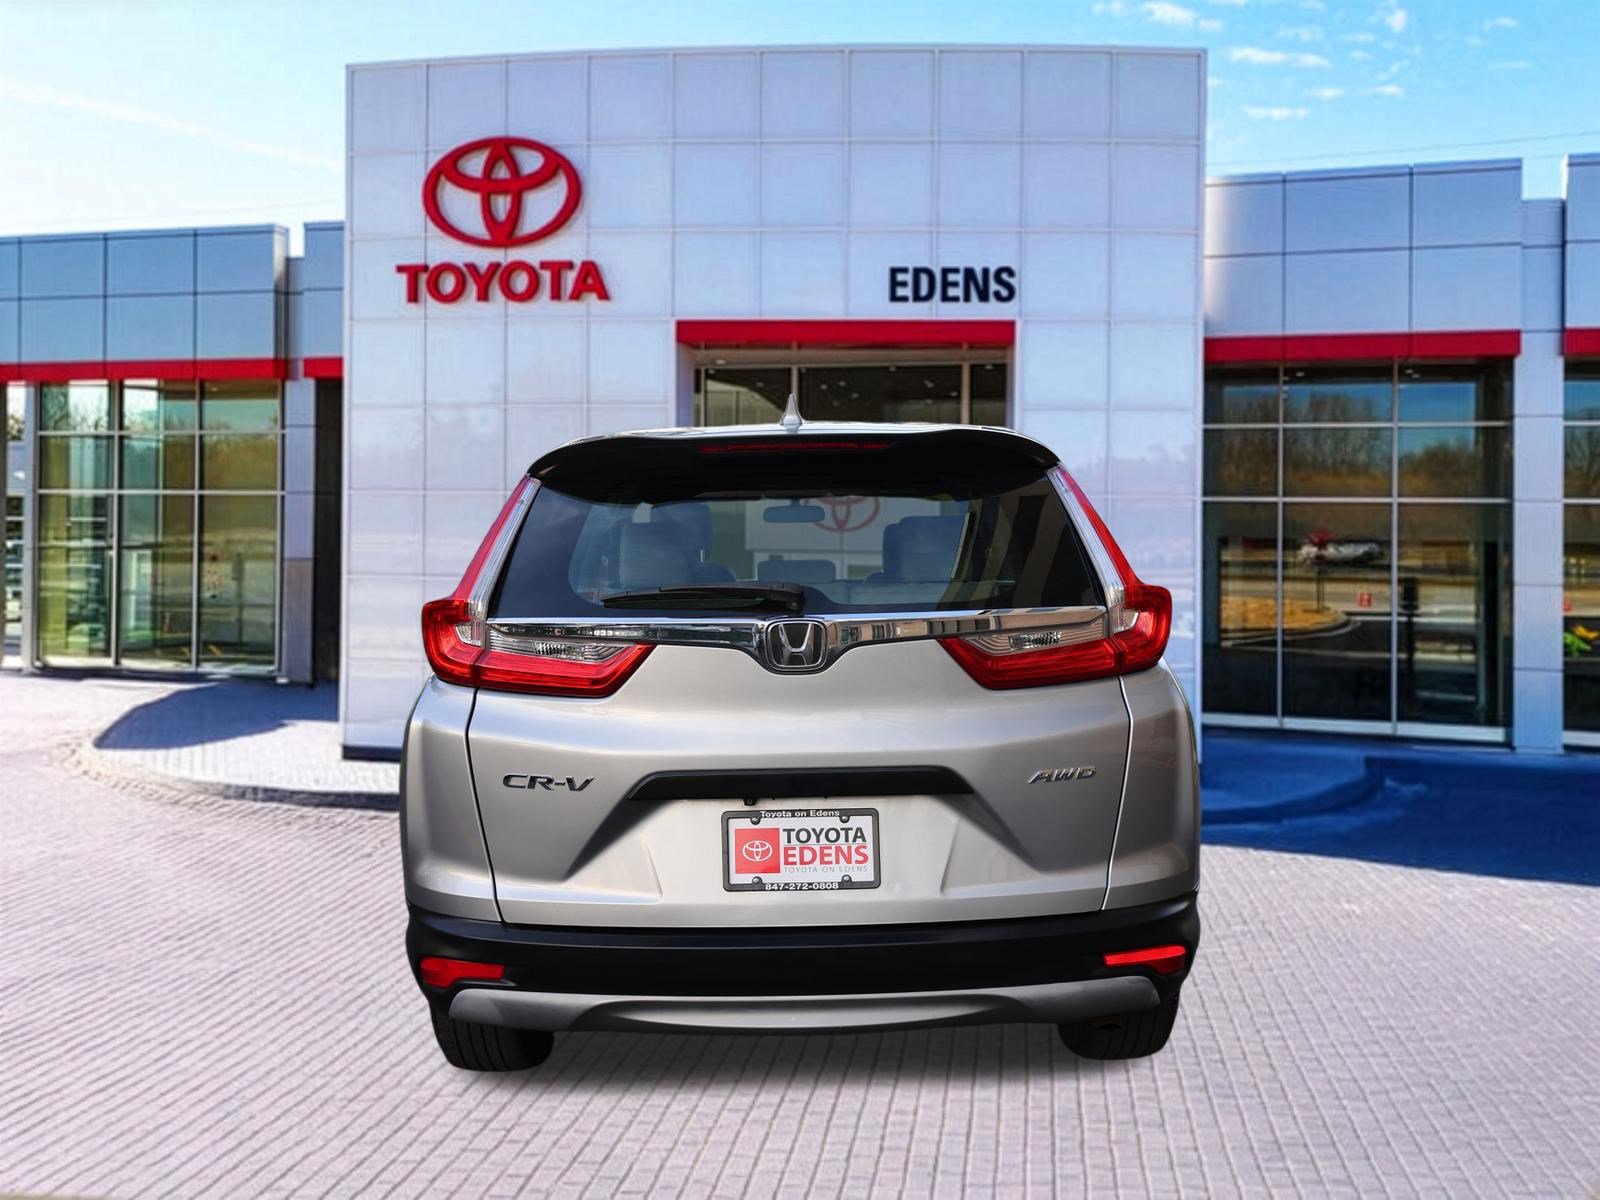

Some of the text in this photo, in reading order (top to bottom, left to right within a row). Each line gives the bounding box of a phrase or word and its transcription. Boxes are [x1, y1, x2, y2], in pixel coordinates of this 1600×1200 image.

[396, 260, 610, 303] TOYOTA
[889, 266, 1017, 303] EDENS
[503, 773, 595, 792] CR-V
[1028, 766, 1096, 784] AWD
[783, 827, 866, 843] TOYOTA
[784, 844, 869, 865] EDENS
[765, 882, 839, 890] 847-272-0808
